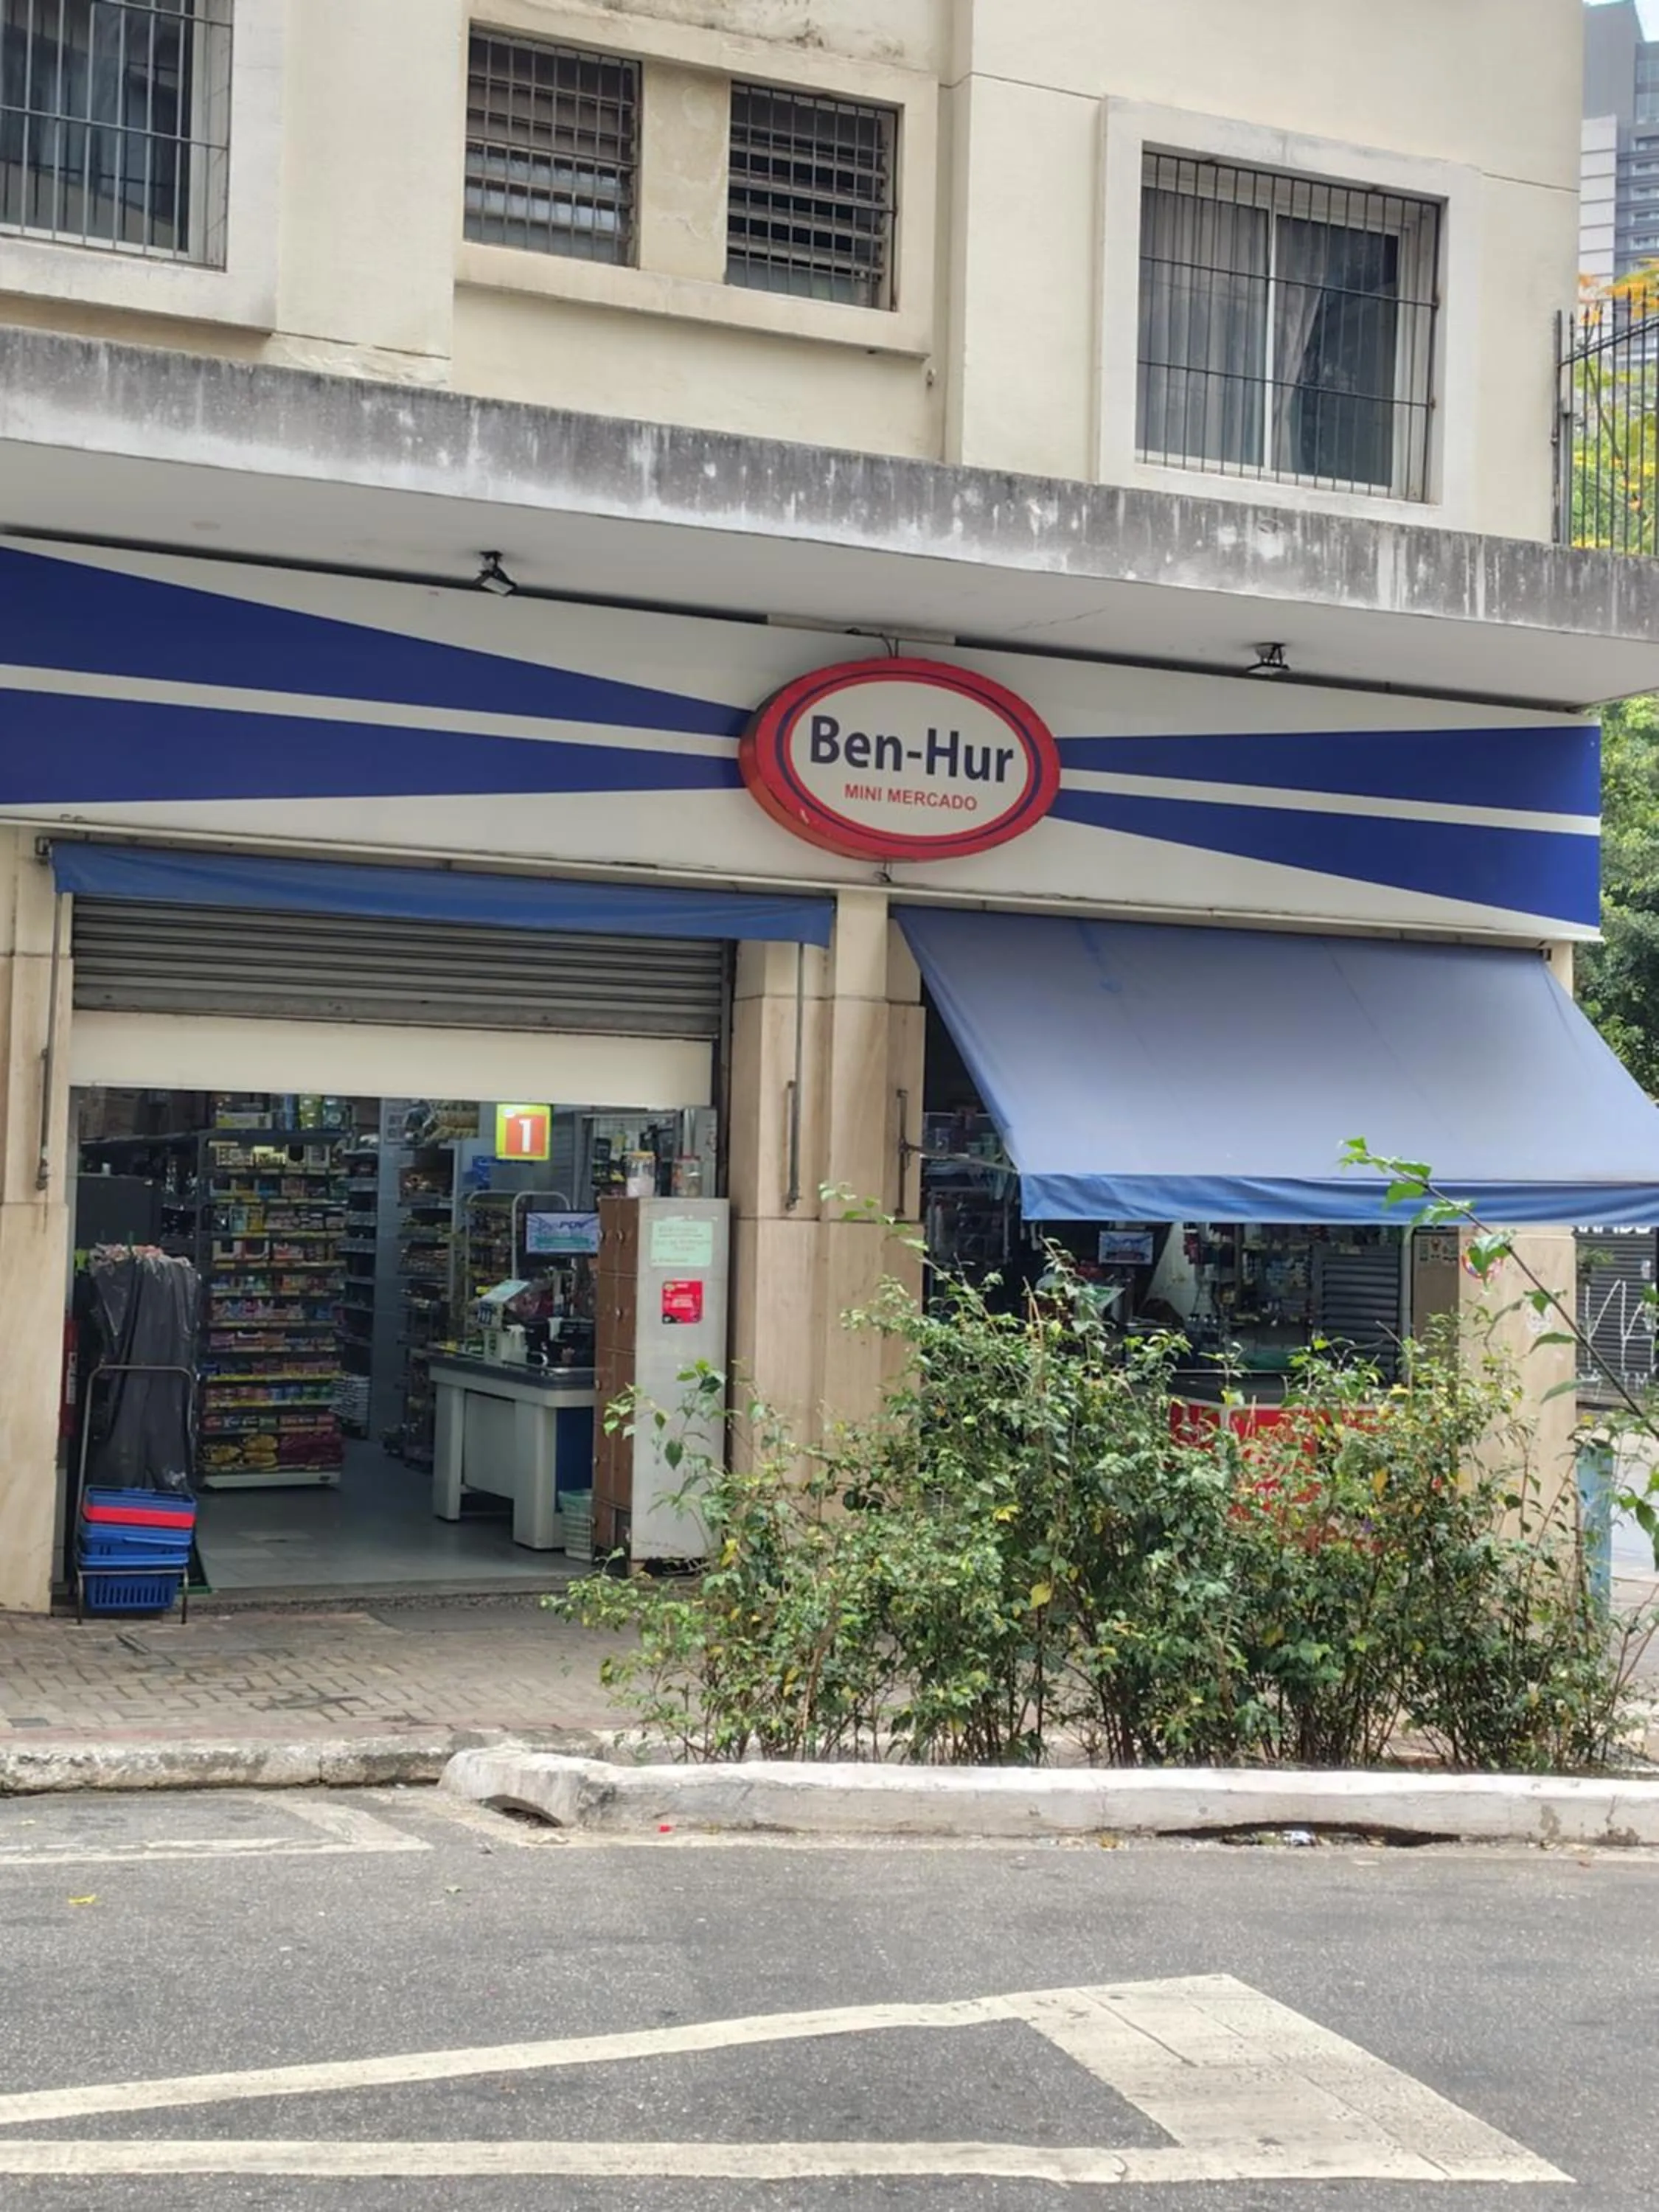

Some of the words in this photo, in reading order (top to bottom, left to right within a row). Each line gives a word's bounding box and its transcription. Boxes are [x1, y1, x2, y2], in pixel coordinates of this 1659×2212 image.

[810, 714, 1014, 782] Ben-Hur
[844, 784, 882, 801] MINI
[887, 789, 978, 810] MERCADO
[518, 1119, 532, 1152] 1
